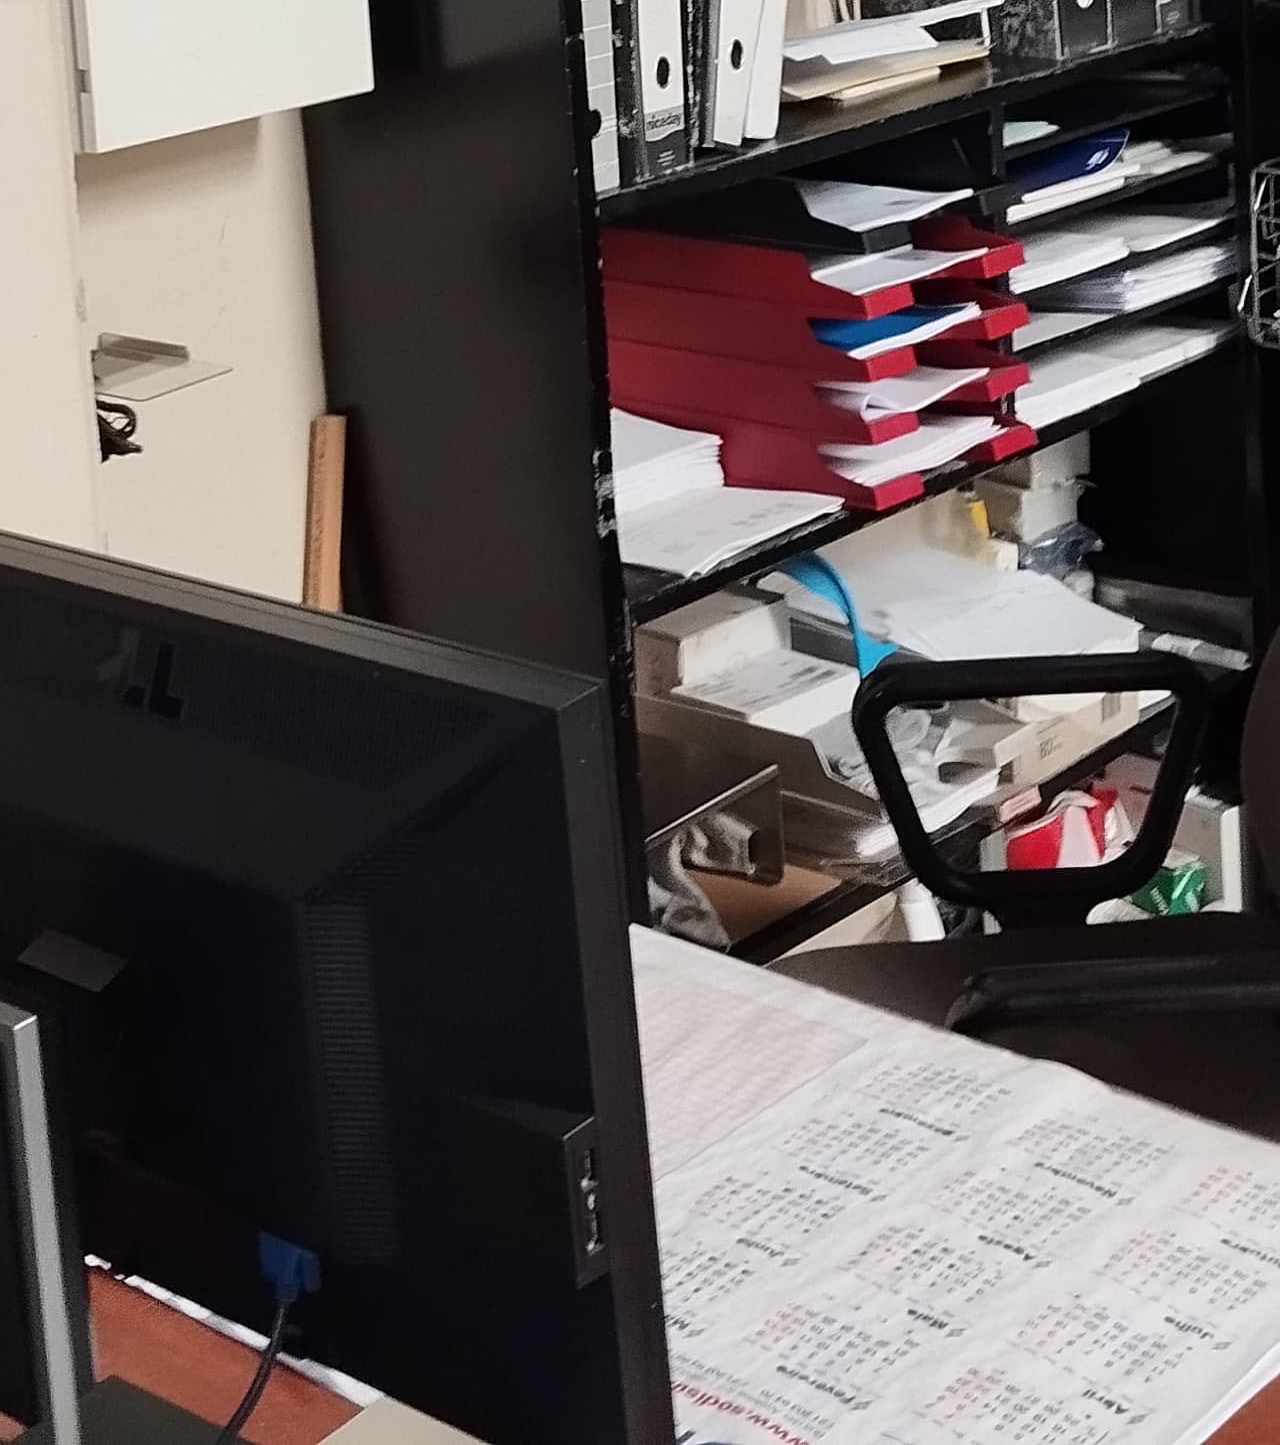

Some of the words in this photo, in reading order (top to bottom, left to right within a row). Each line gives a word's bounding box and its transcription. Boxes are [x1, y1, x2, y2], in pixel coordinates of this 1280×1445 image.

[646, 114, 682, 131] niceday
[906, 1307, 948, 1337] Maio
[1082, 1387, 1125, 1419] Abril
